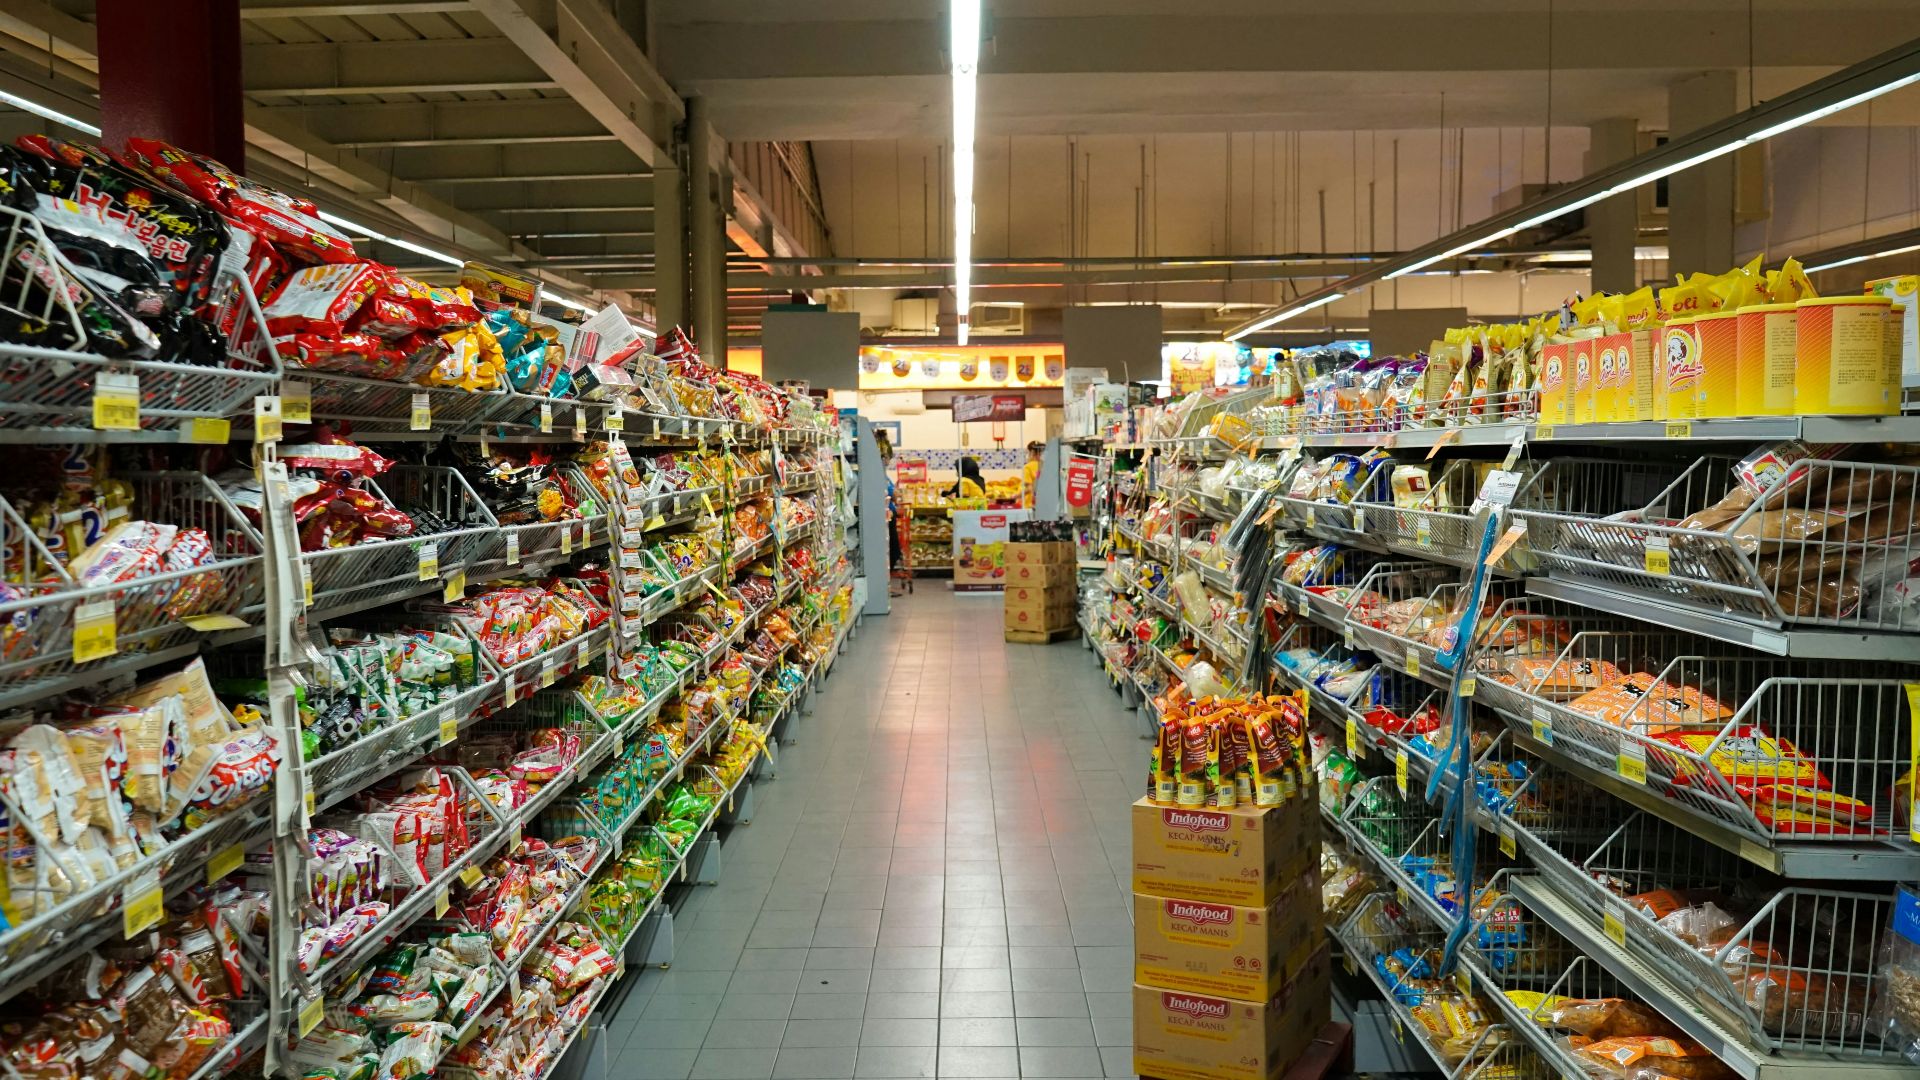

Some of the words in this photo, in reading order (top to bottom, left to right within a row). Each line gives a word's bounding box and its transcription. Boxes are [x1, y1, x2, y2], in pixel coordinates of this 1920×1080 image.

[82, 509, 106, 547] 2
[682, 556, 693, 567] 2
[725, 618, 733, 629] 2
[1170, 812, 1226, 830] Indofood
[1168, 832, 1194, 842] KECAP
[1173, 903, 1229, 921] Indofood
[1171, 923, 1198, 933] KECAP
[1200, 927, 1229, 937] MANIS
[1169, 996, 1226, 1014] Indofood
[1167, 1016, 1194, 1026] KECAP
[1197, 1020, 1225, 1031] MANIS
